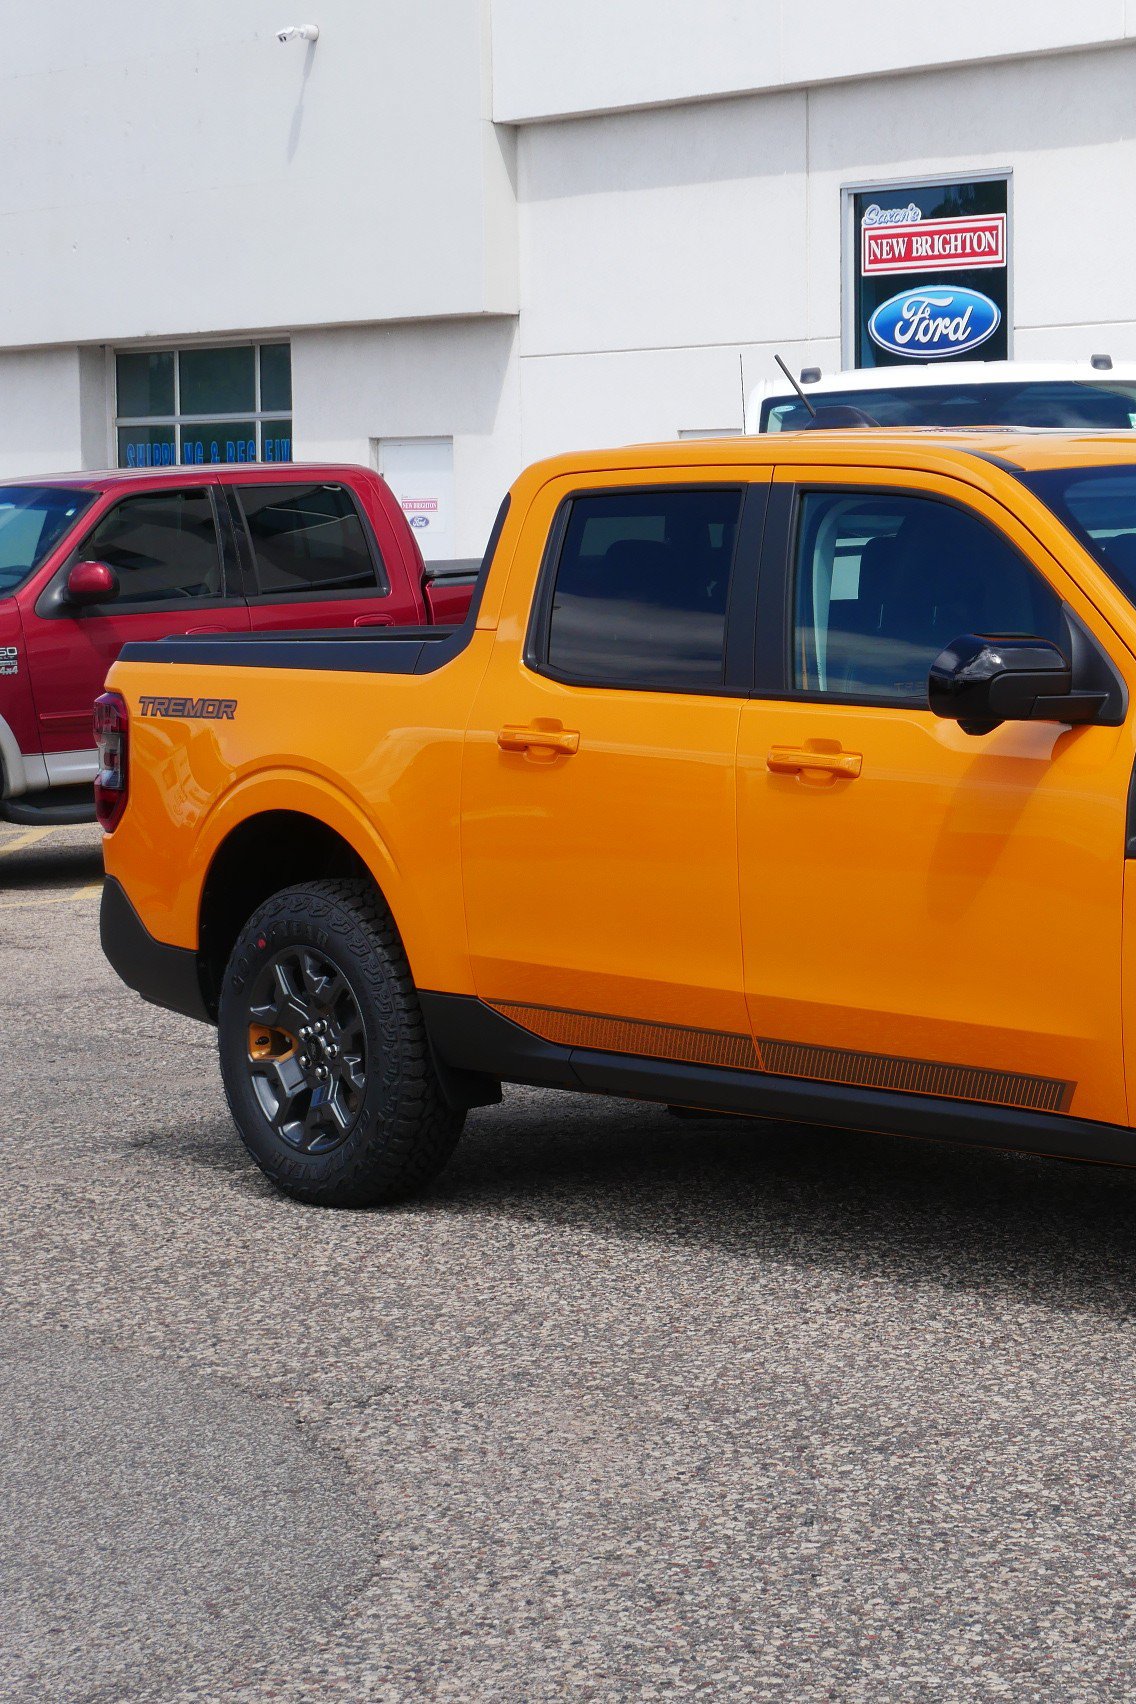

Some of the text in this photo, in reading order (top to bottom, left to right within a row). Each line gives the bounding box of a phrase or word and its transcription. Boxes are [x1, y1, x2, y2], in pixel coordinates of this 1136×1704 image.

[863, 204, 921, 226] Saxon's
[869, 230, 998, 260] NEW BRIGHTON
[894, 296, 974, 344] Ford
[138, 695, 238, 720] TREMOR
